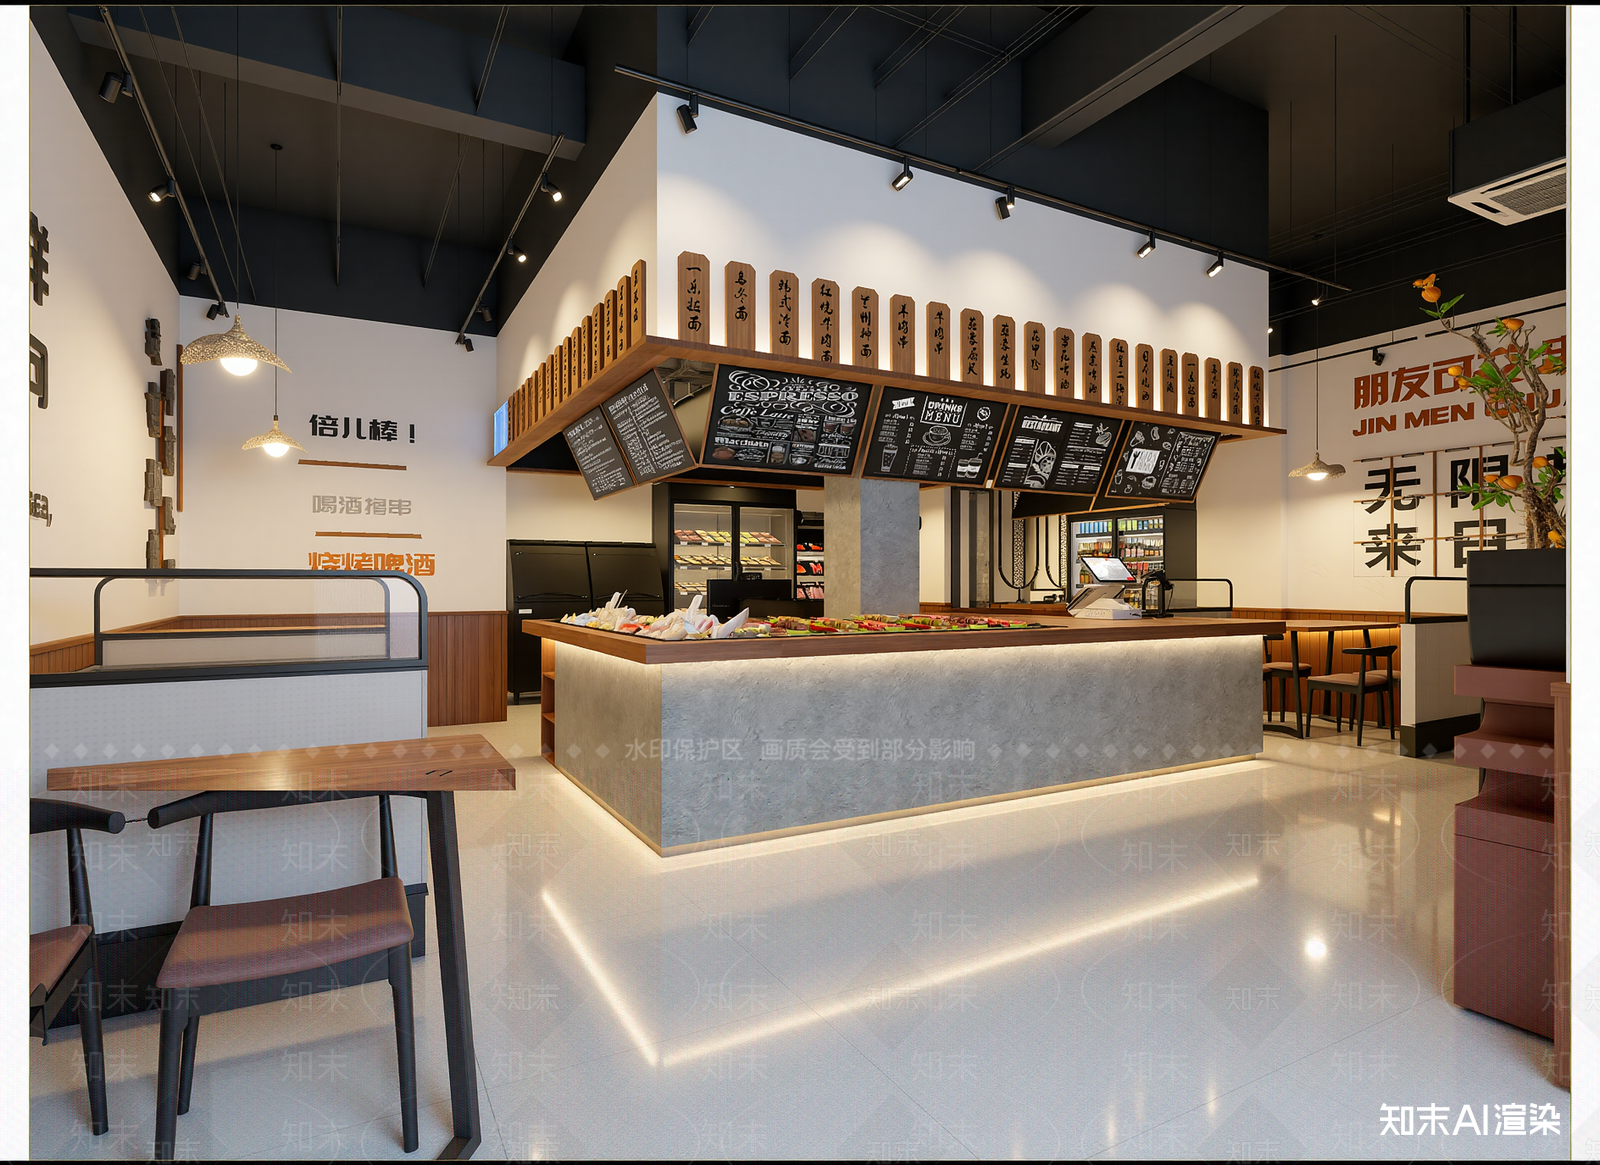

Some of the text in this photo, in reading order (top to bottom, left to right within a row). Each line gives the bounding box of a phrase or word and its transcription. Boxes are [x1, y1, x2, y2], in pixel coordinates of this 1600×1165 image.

[728, 390, 859, 403] ESPRESSO
[924, 409, 960, 424] MENU
[1353, 415, 1397, 437] JIN
[1404, 402, 1475, 429] MEN
[308, 551, 435, 577] 烧烤啤酒
